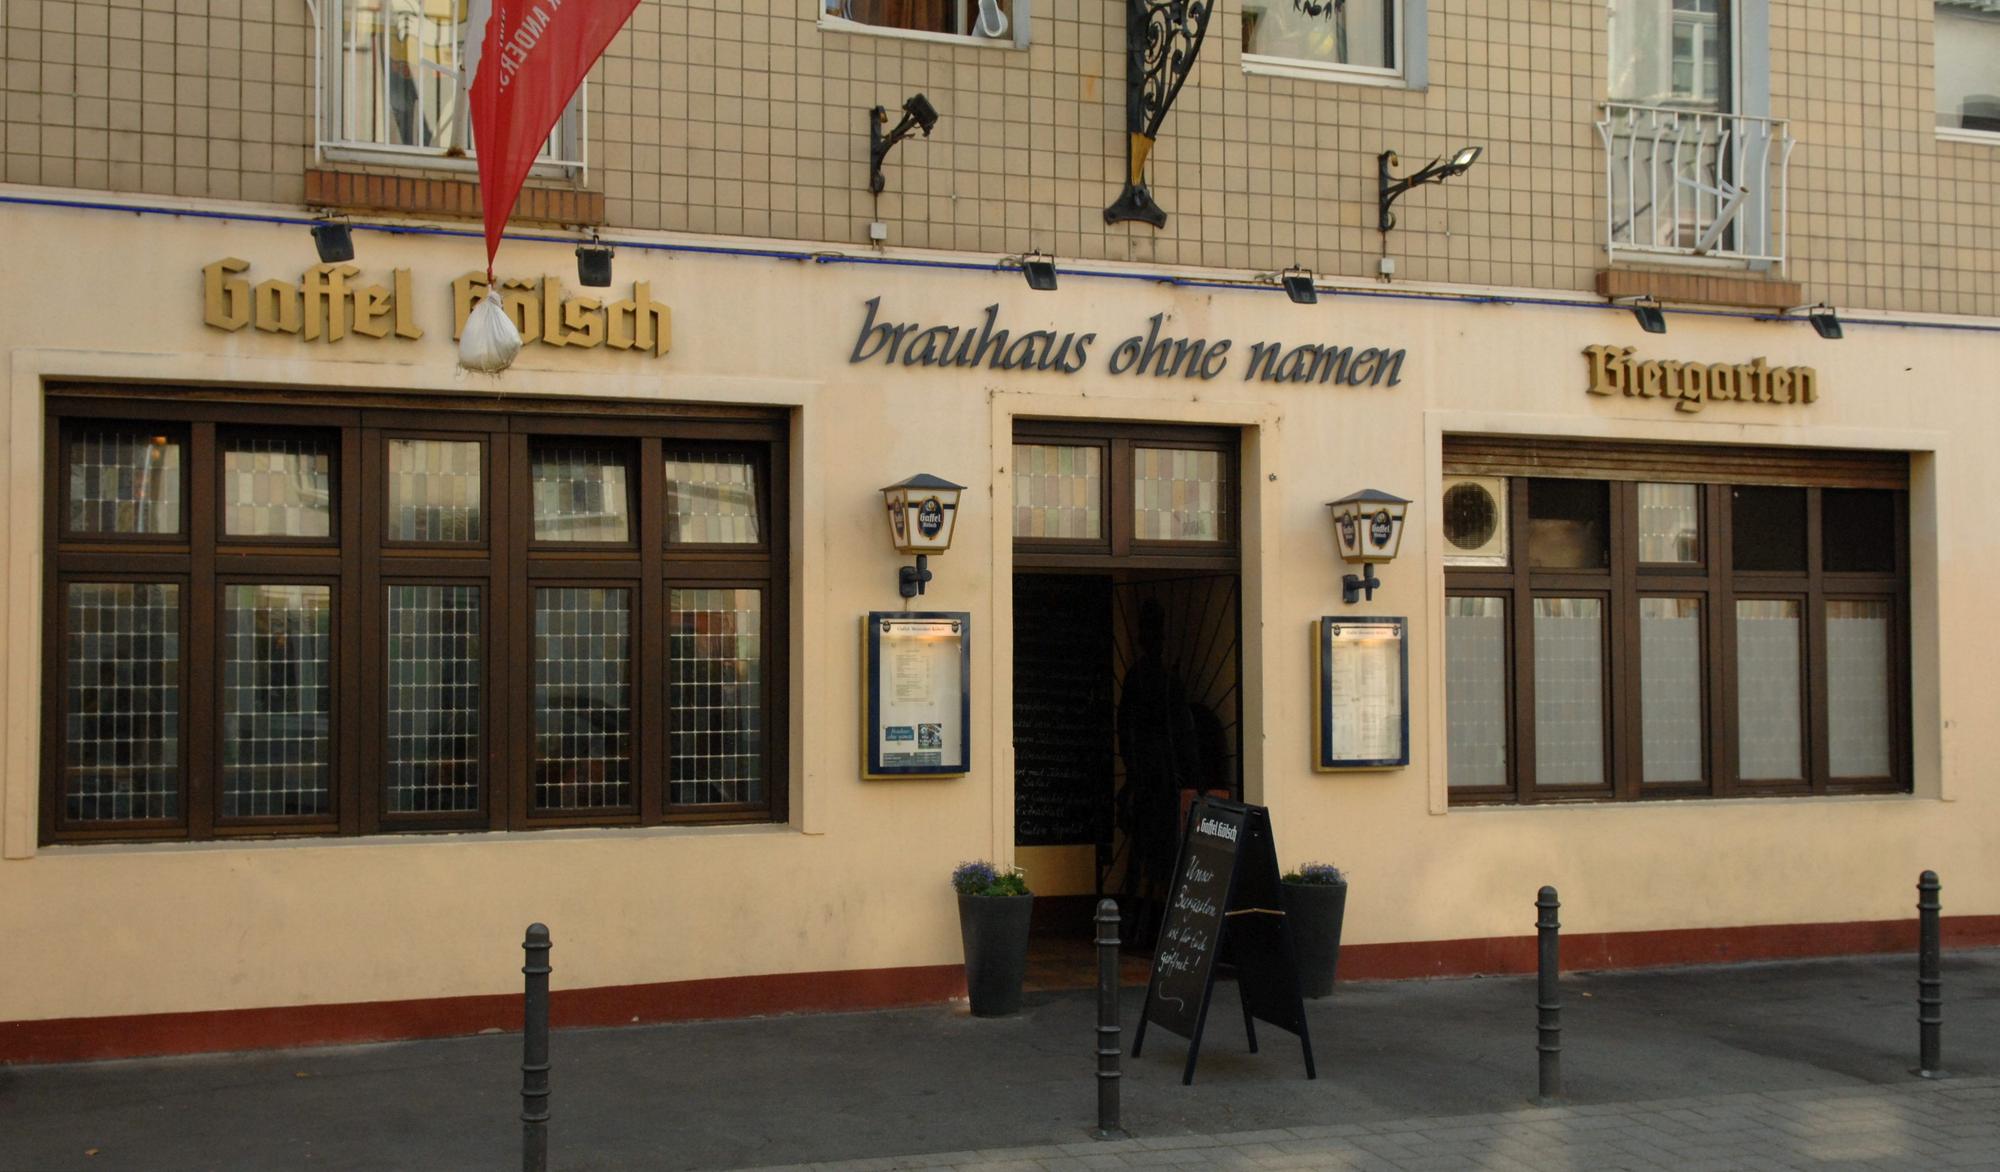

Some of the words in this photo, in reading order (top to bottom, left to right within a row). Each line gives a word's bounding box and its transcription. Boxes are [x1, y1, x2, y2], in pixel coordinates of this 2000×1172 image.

[202, 256, 424, 343] Gaffel
[849, 296, 1096, 374] brauhaus
[1108, 312, 1232, 379] ohne
[1244, 340, 1407, 388] namen
[1582, 344, 1819, 414] Biergarten
